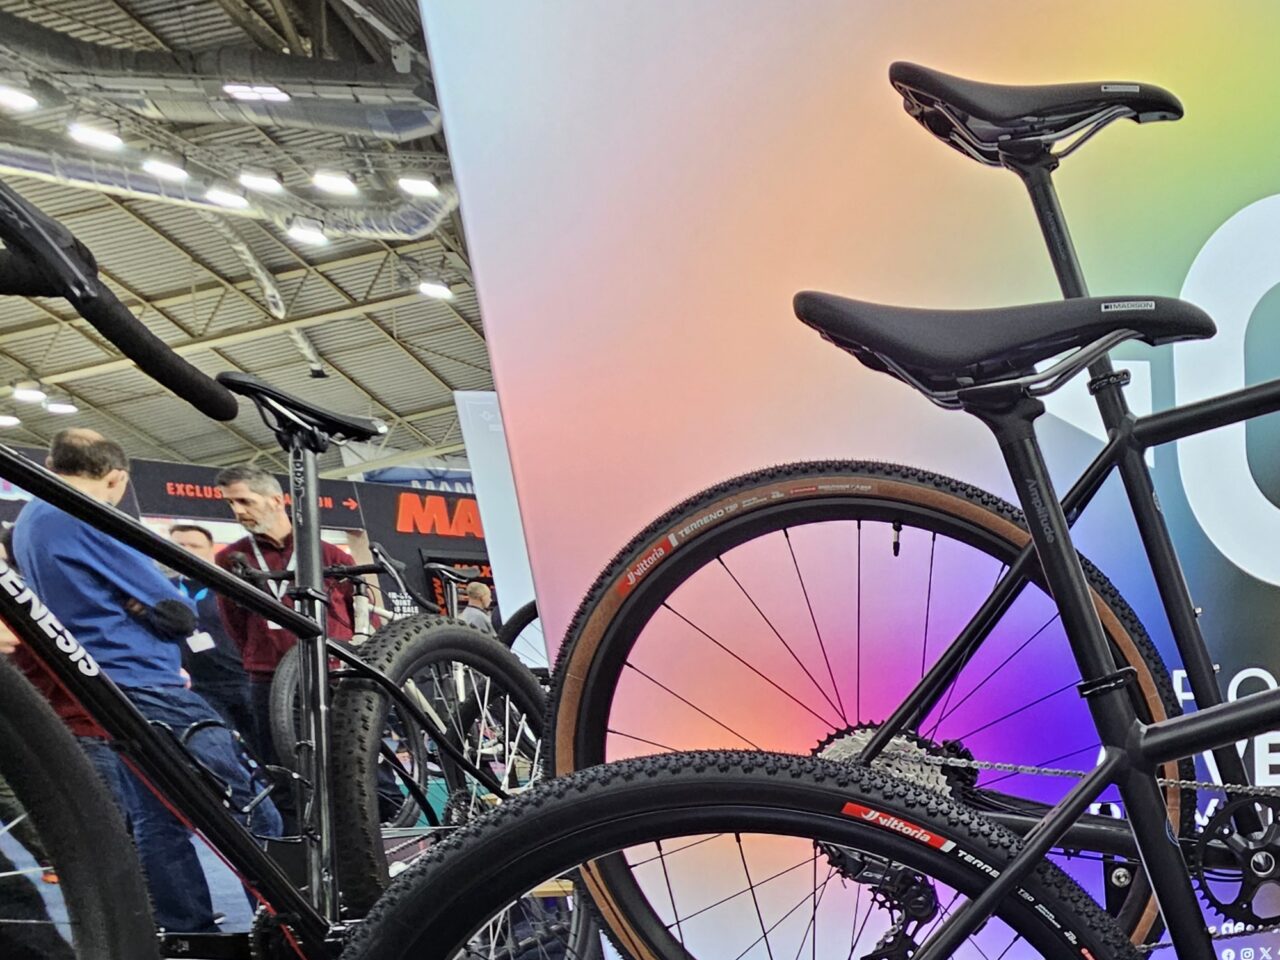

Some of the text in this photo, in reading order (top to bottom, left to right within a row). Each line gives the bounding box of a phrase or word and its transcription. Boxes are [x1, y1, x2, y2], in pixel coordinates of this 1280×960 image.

[1113, 302, 1154, 312] MADISON
[635, 547, 665, 579] vittoria
[677, 508, 725, 538] TERRENO
[878, 815, 931, 843] vittoria
[957, 849, 1001, 879] TERRE
